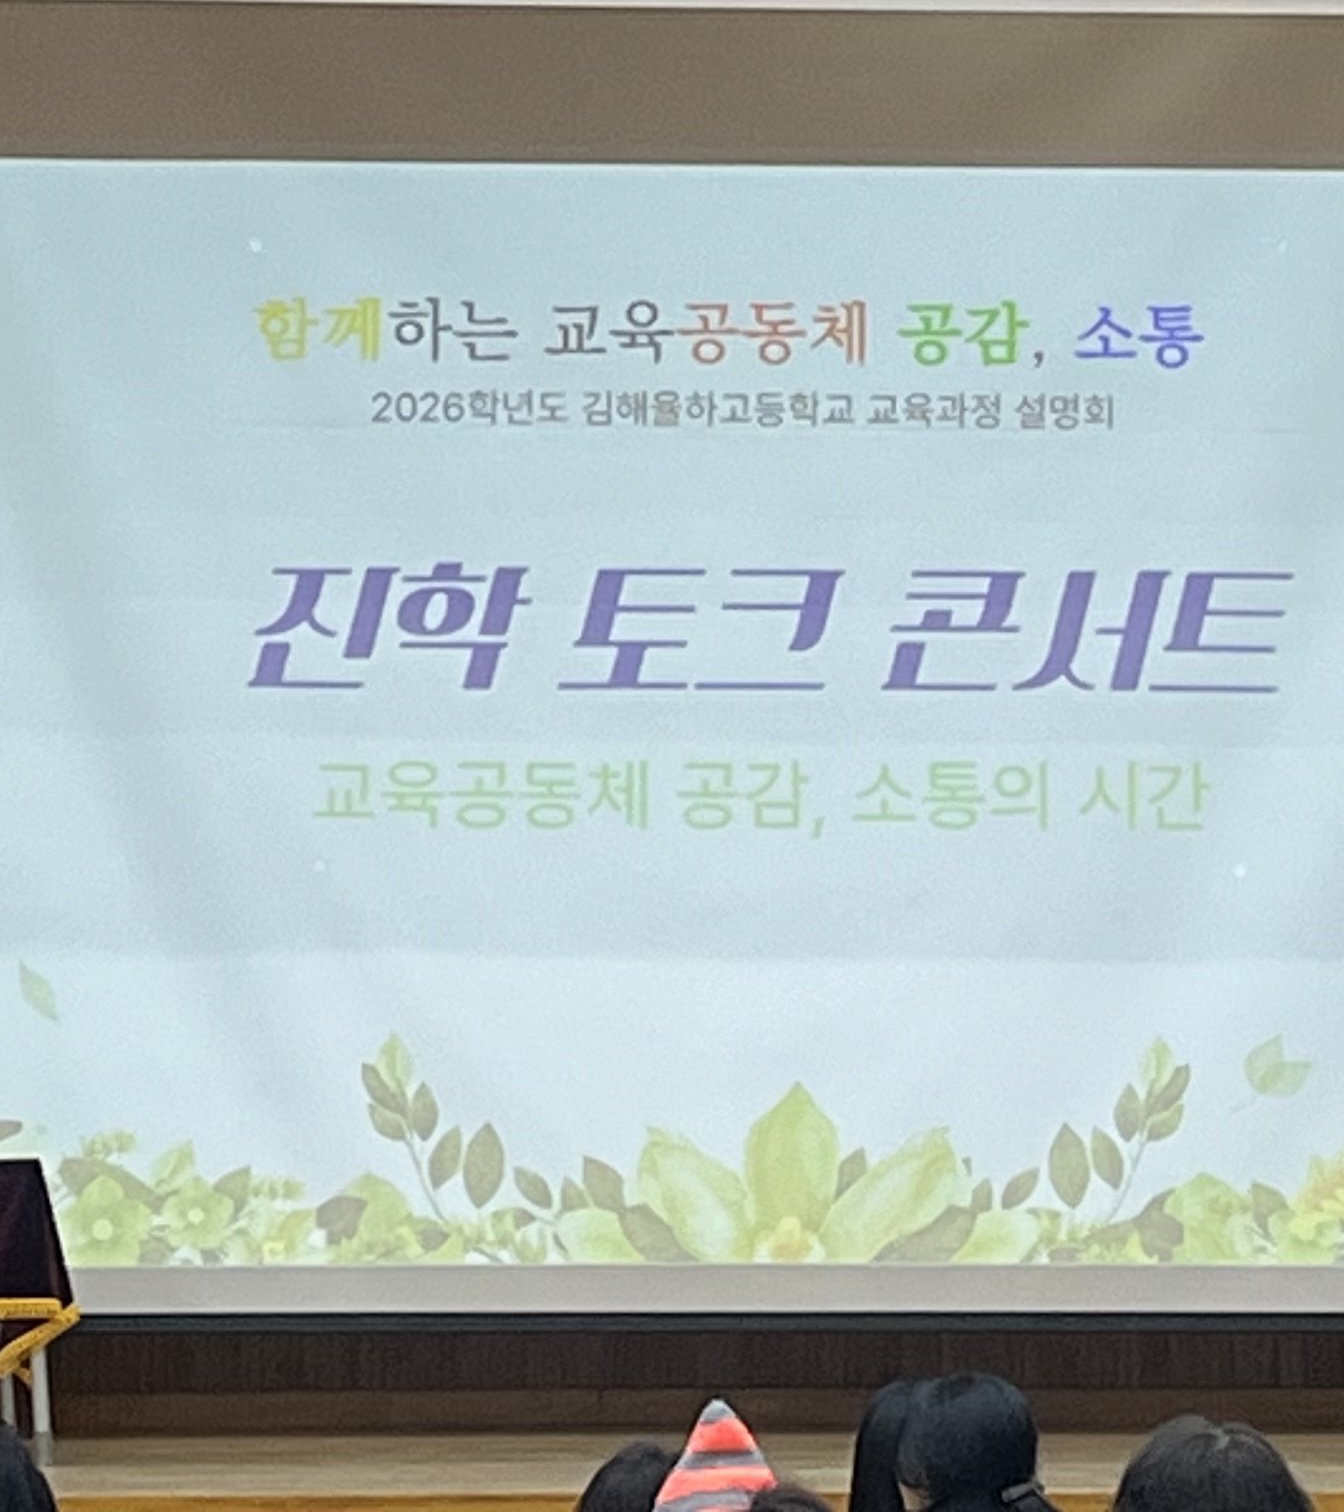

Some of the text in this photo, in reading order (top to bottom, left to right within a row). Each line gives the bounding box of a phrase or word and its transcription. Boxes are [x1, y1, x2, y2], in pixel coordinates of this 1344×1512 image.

[254, 296, 1205, 370] 함께하는 교육공동체 공감, 소통
[371, 390, 1114, 431] 2026학년도 김해율하고등학교 교육과정 설명회
[247, 561, 1294, 693] 진학 토크 콘서트
[312, 759, 1212, 839] 교육공동체 공감, 소통의 시간
